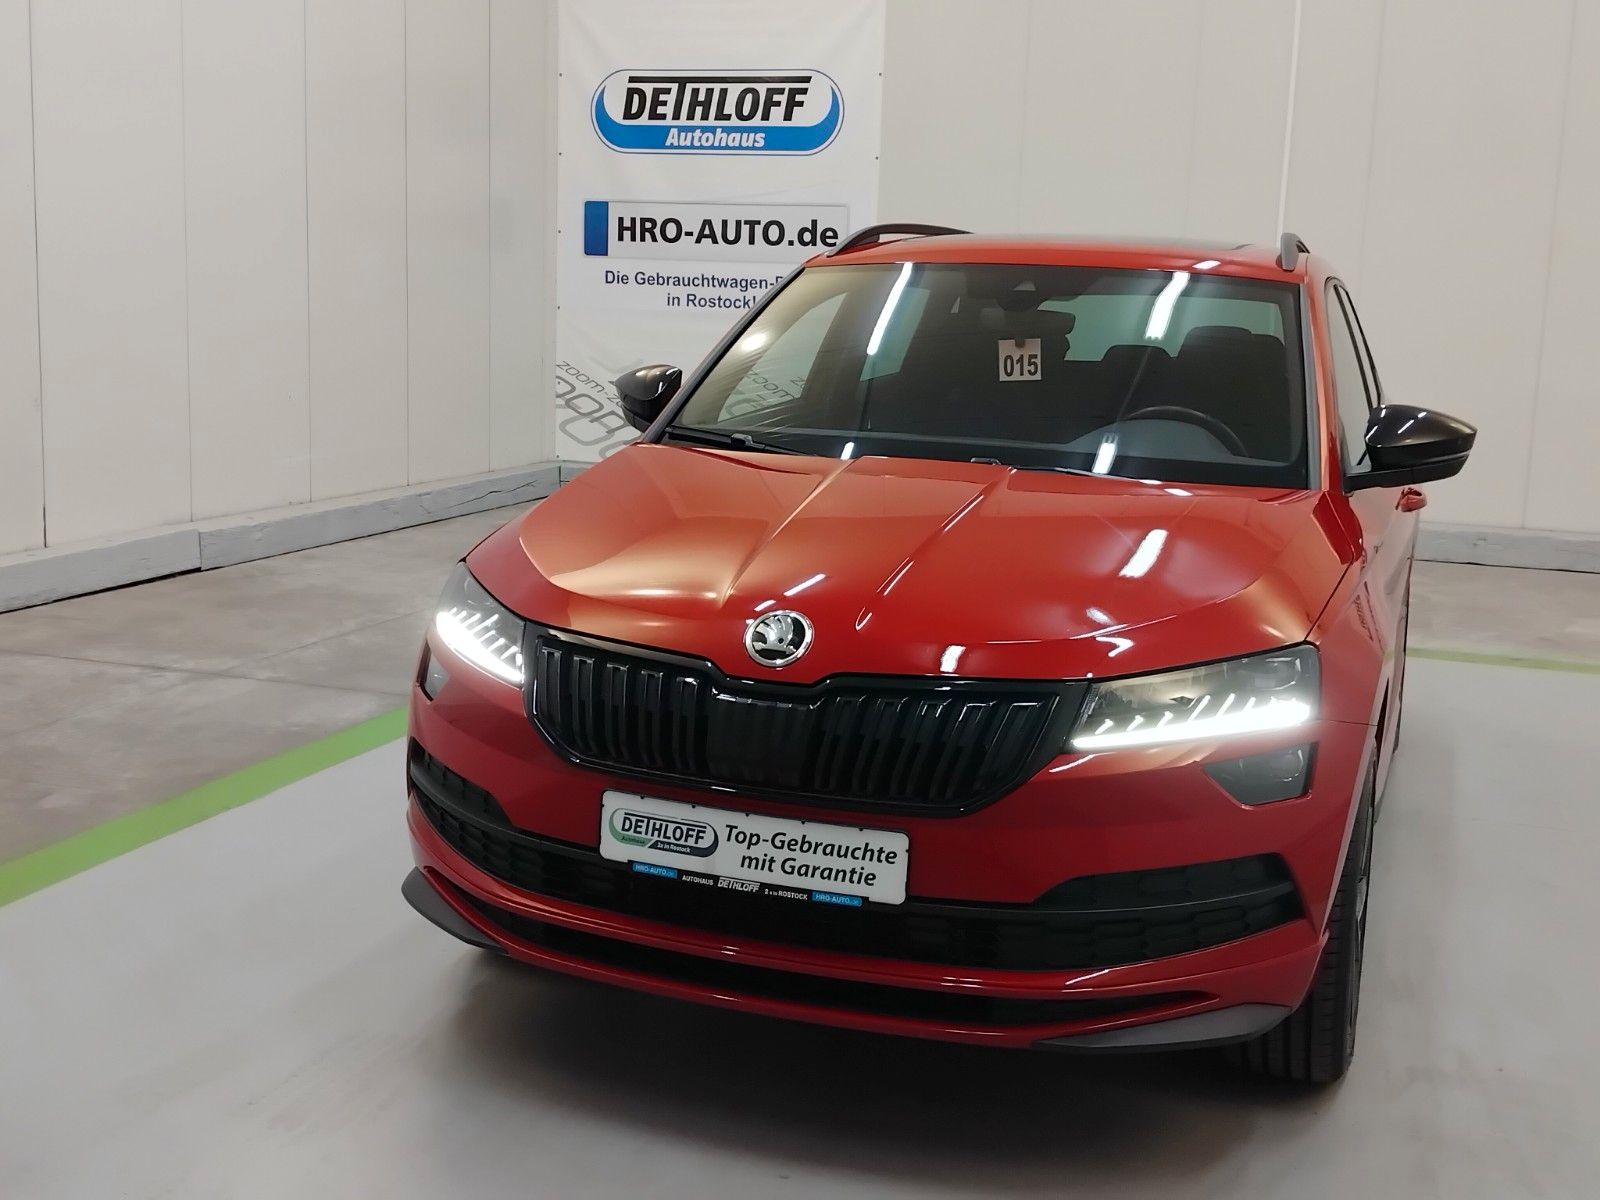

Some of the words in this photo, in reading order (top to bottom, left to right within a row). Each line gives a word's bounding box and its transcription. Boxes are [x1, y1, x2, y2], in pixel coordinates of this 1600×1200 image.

[622, 75, 813, 122] DETHLOFF
[665, 128, 766, 148] Autohaus
[616, 216, 839, 247] HRO-AUTO.de
[604, 270, 630, 285] Die
[667, 293, 681, 307] in
[1003, 354, 1039, 377] 015
[621, 812, 707, 845] DETHLOFF
[725, 824, 898, 865] Top-Gebrauchte
[740, 853, 776, 873] mit
[780, 856, 877, 887] Garantie
[682, 875, 714, 886] AUTOHAUS
[717, 876, 761, 893] DETHLOFF
[778, 890, 808, 900] ROSTOCK
